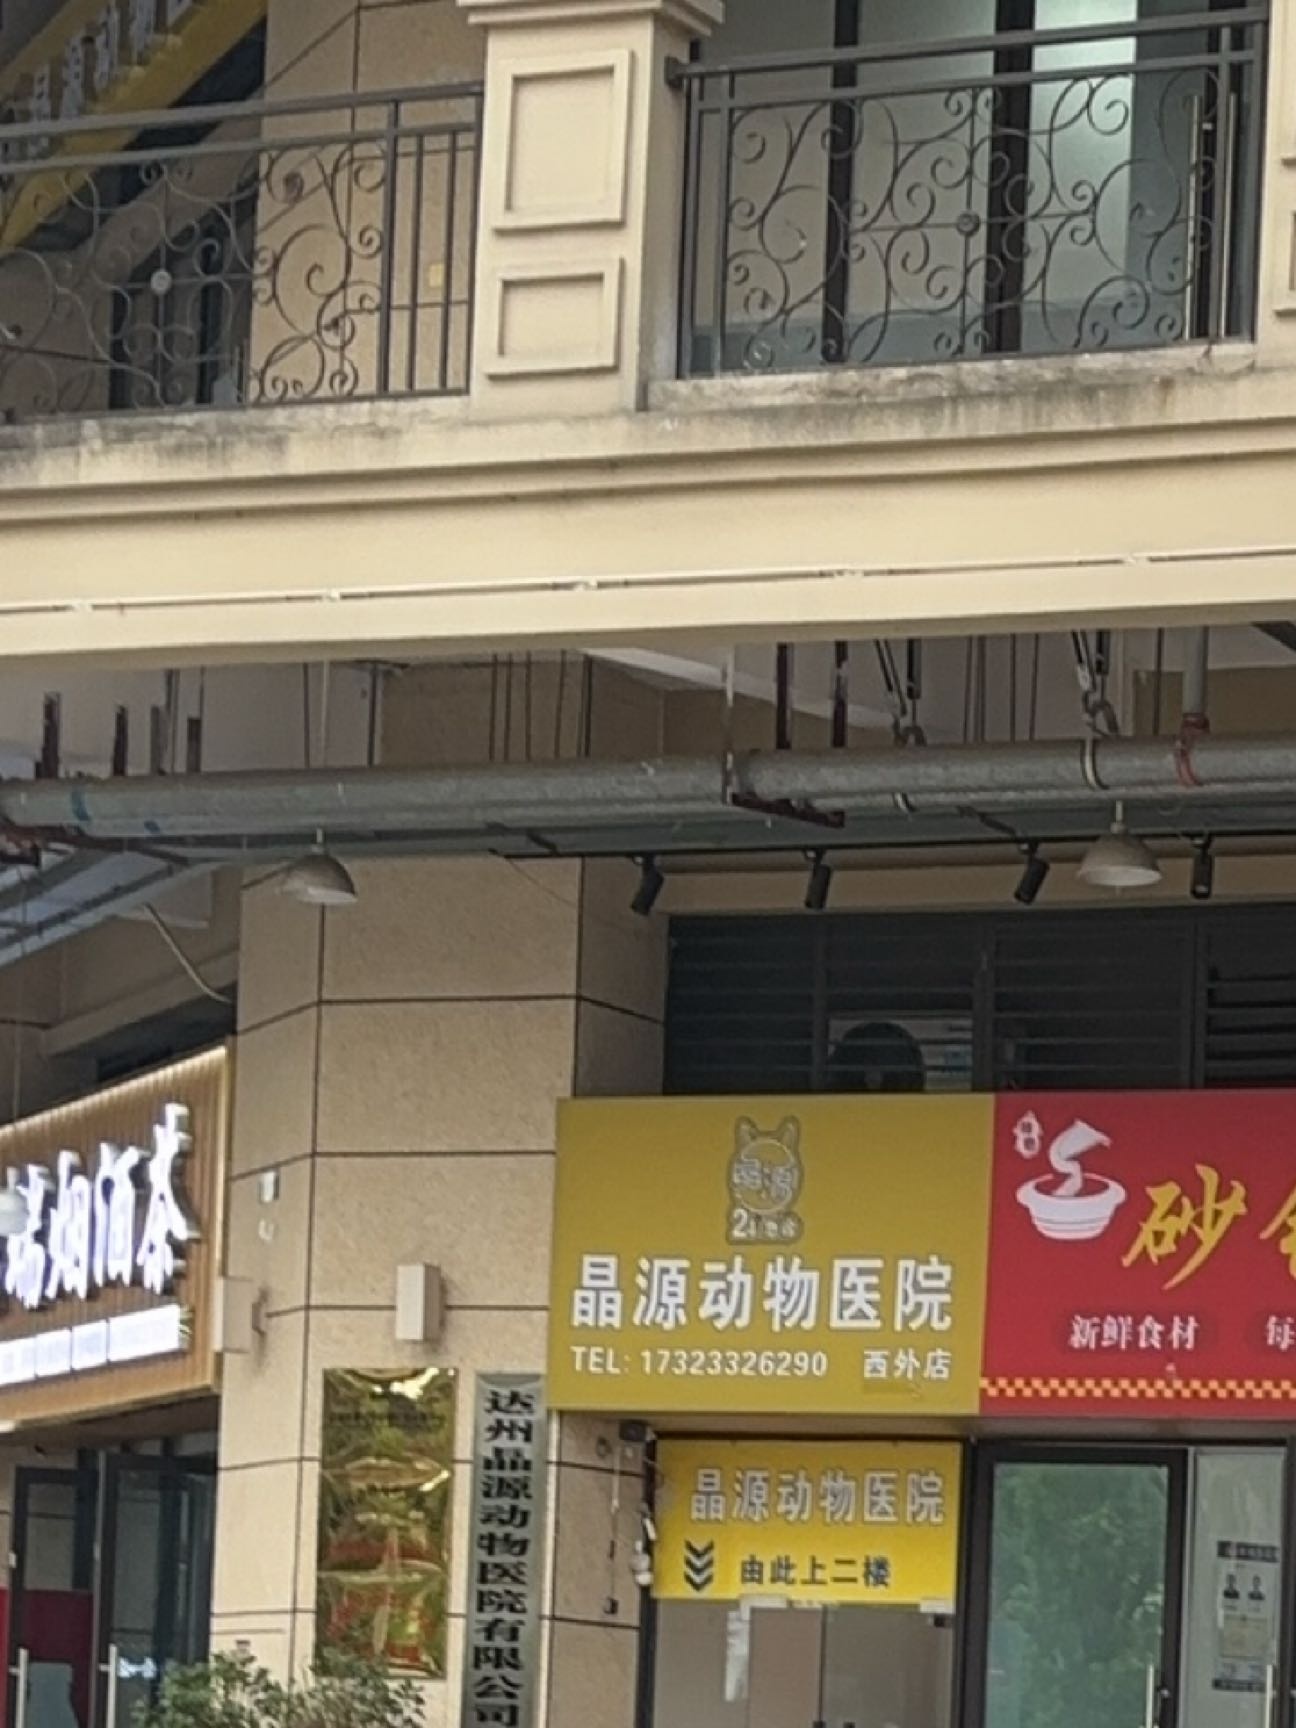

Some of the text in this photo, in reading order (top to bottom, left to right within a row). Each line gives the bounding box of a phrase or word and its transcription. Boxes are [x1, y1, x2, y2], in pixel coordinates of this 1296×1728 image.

[572, 1255, 952, 1332] 晶源动物医院
[1068, 1315, 1199, 1352] 新鲜食材
[641, 1349, 828, 1377] 17323326290
[863, 1348, 952, 1380] 西外店
[690, 1467, 945, 1523] 晶源动物医院
[740, 1555, 892, 1588] 由此上二楼
